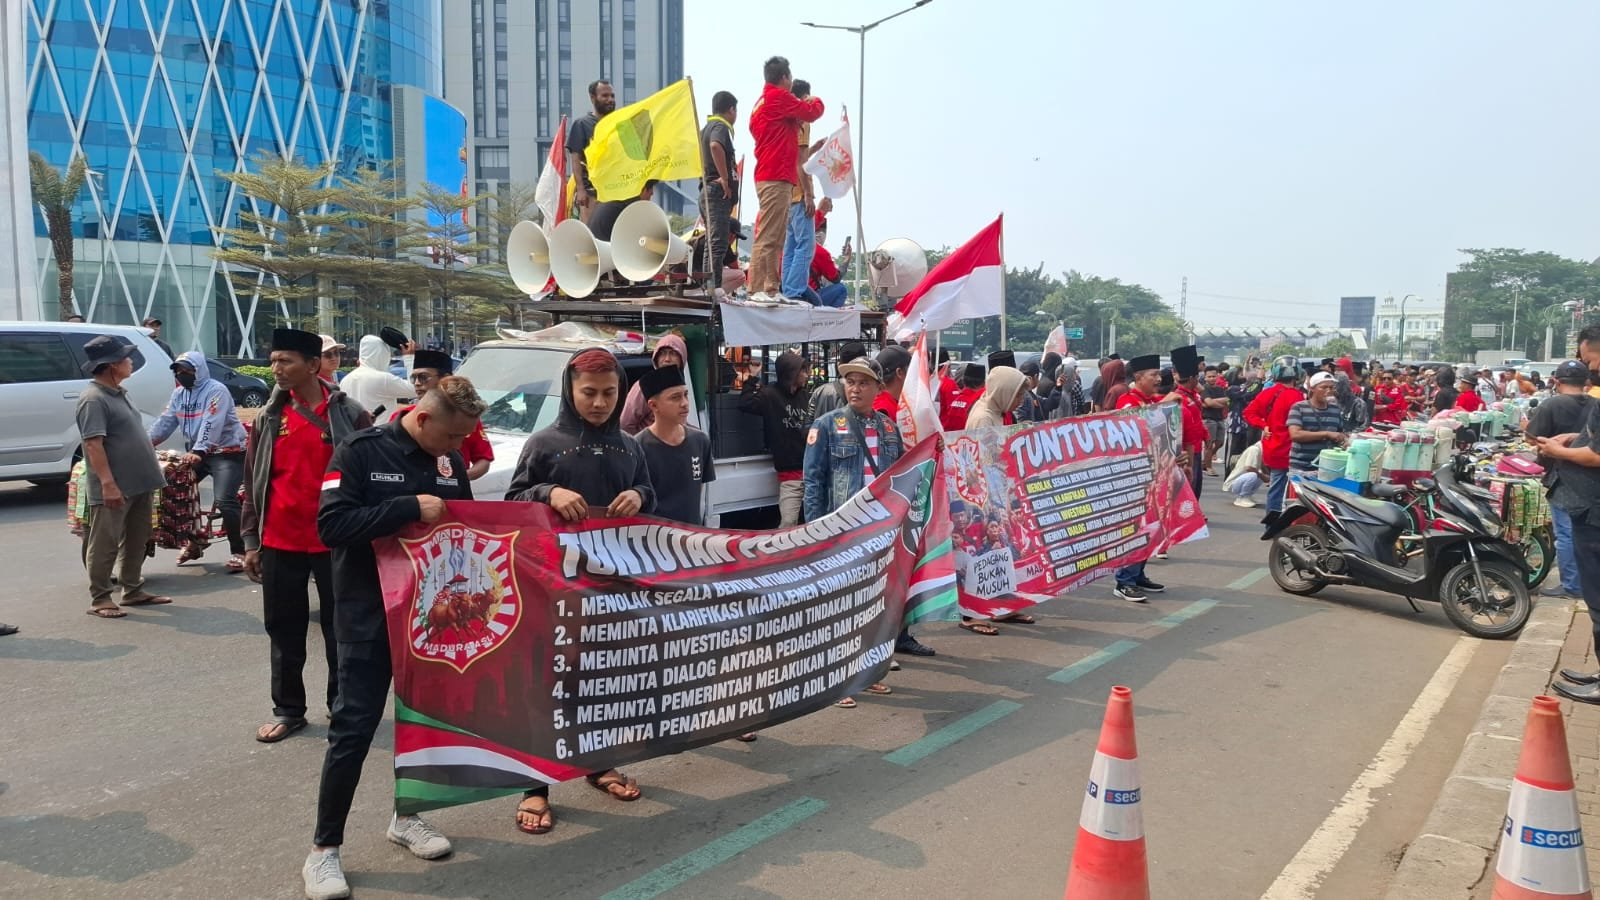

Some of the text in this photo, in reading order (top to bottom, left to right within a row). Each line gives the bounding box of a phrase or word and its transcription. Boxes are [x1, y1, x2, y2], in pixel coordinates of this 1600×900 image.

[1010, 419, 1143, 478] TUNTUTAN
[557, 600, 573, 617] 1.
[582, 590, 652, 617] MENOLAK
[654, 584, 712, 606] SEGALA
[712, 576, 761, 597] BENTUK
[754, 565, 816, 589] INTIMIDASI
[810, 546, 865, 574] TERHADAP
[558, 524, 742, 578] TUNTUTAN
[973, 552, 1009, 573] PEDAGANG
[978, 567, 1006, 584] BUKAN
[554, 626, 572, 645] 2.
[580, 617, 659, 642] MEMINTA
[661, 600, 744, 633] KLARIFIKASI
[746, 583, 819, 615] MANAJEMEN
[820, 560, 877, 596] SUMMARECON
[976, 579, 1010, 596] MUSUH
[424, 642, 473, 653] MADURA
[552, 681, 570, 699] 4.
[578, 671, 657, 697] MEMINTA
[662, 658, 716, 686] DIALOG
[720, 644, 772, 675] ANTARA
[776, 626, 831, 660] PEDAGANG
[833, 616, 852, 639] DAN
[553, 655, 572, 673] 3.
[579, 644, 659, 671] MEMINTA
[663, 627, 752, 660] INVESTIGASI
[756, 611, 803, 640] DUGAAN
[805, 592, 852, 624] TINDAKAN
[553, 634, 862, 730] 5. MEMINTA PEMERINTAH MELAKUKAN MEDIASI
[555, 738, 573, 760] 6.
[578, 722, 654, 754] MEMINTA
[659, 703, 736, 737] PENATAAN
[739, 697, 765, 719] PKL
[768, 686, 800, 710] YANG
[802, 677, 826, 698] ADIL
[828, 665, 847, 688] DAN
